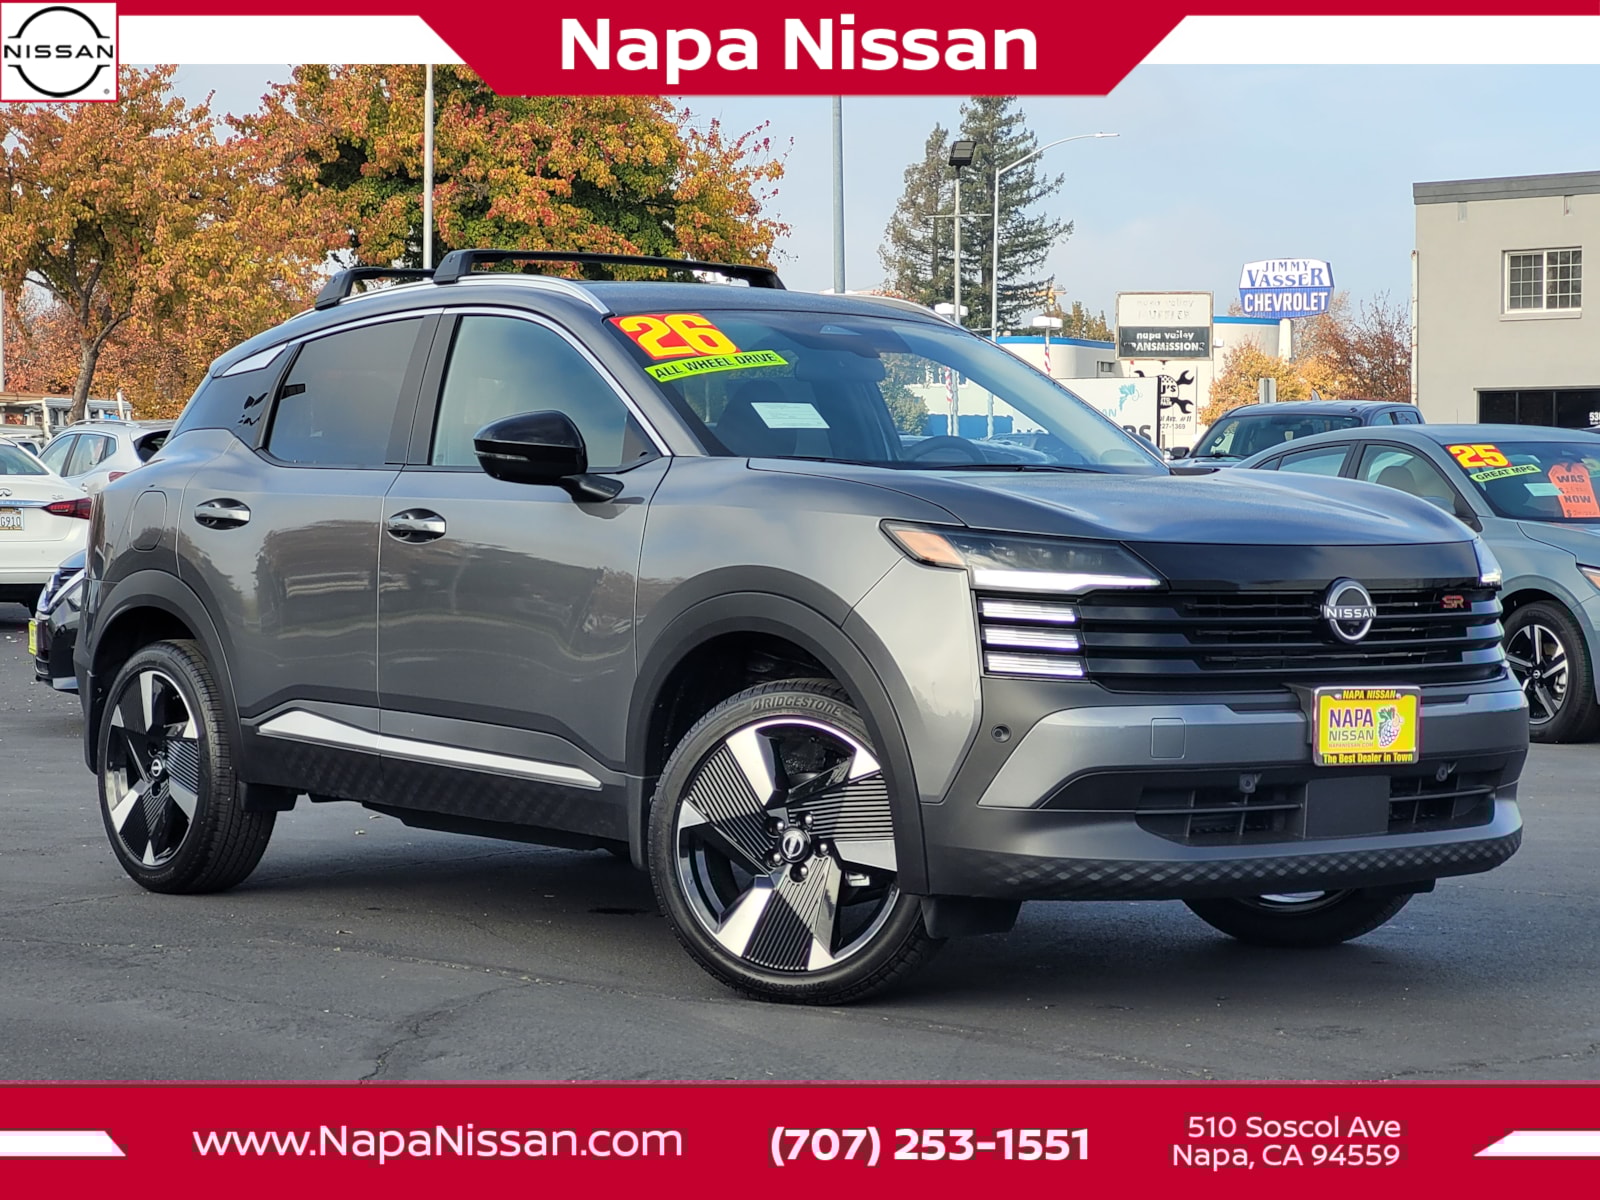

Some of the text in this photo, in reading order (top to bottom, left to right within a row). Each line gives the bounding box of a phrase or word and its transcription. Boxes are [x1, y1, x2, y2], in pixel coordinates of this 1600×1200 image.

[1262, 261, 1310, 272] JIMMY
[1247, 268, 1325, 287] VASSER
[1244, 292, 1328, 312] CHEVROLET
[619, 313, 738, 358] 26
[1136, 332, 1161, 341] napa
[654, 352, 778, 379] ALL WHEEL DRIVE
[1449, 444, 1509, 468] 25
[1475, 464, 1536, 481] GREAT MPG
[1556, 474, 1585, 483] WAS
[1563, 495, 1591, 504] NOW
[1325, 606, 1377, 619] NISSAN
[1343, 689, 1396, 700] NAPA NISSAN
[752, 695, 841, 716] BRIDGESTONE
[1329, 708, 1374, 728] NAPA
[1328, 730, 1374, 741] NISSAN
[1323, 753, 1413, 764] The Best Dealer in Town
